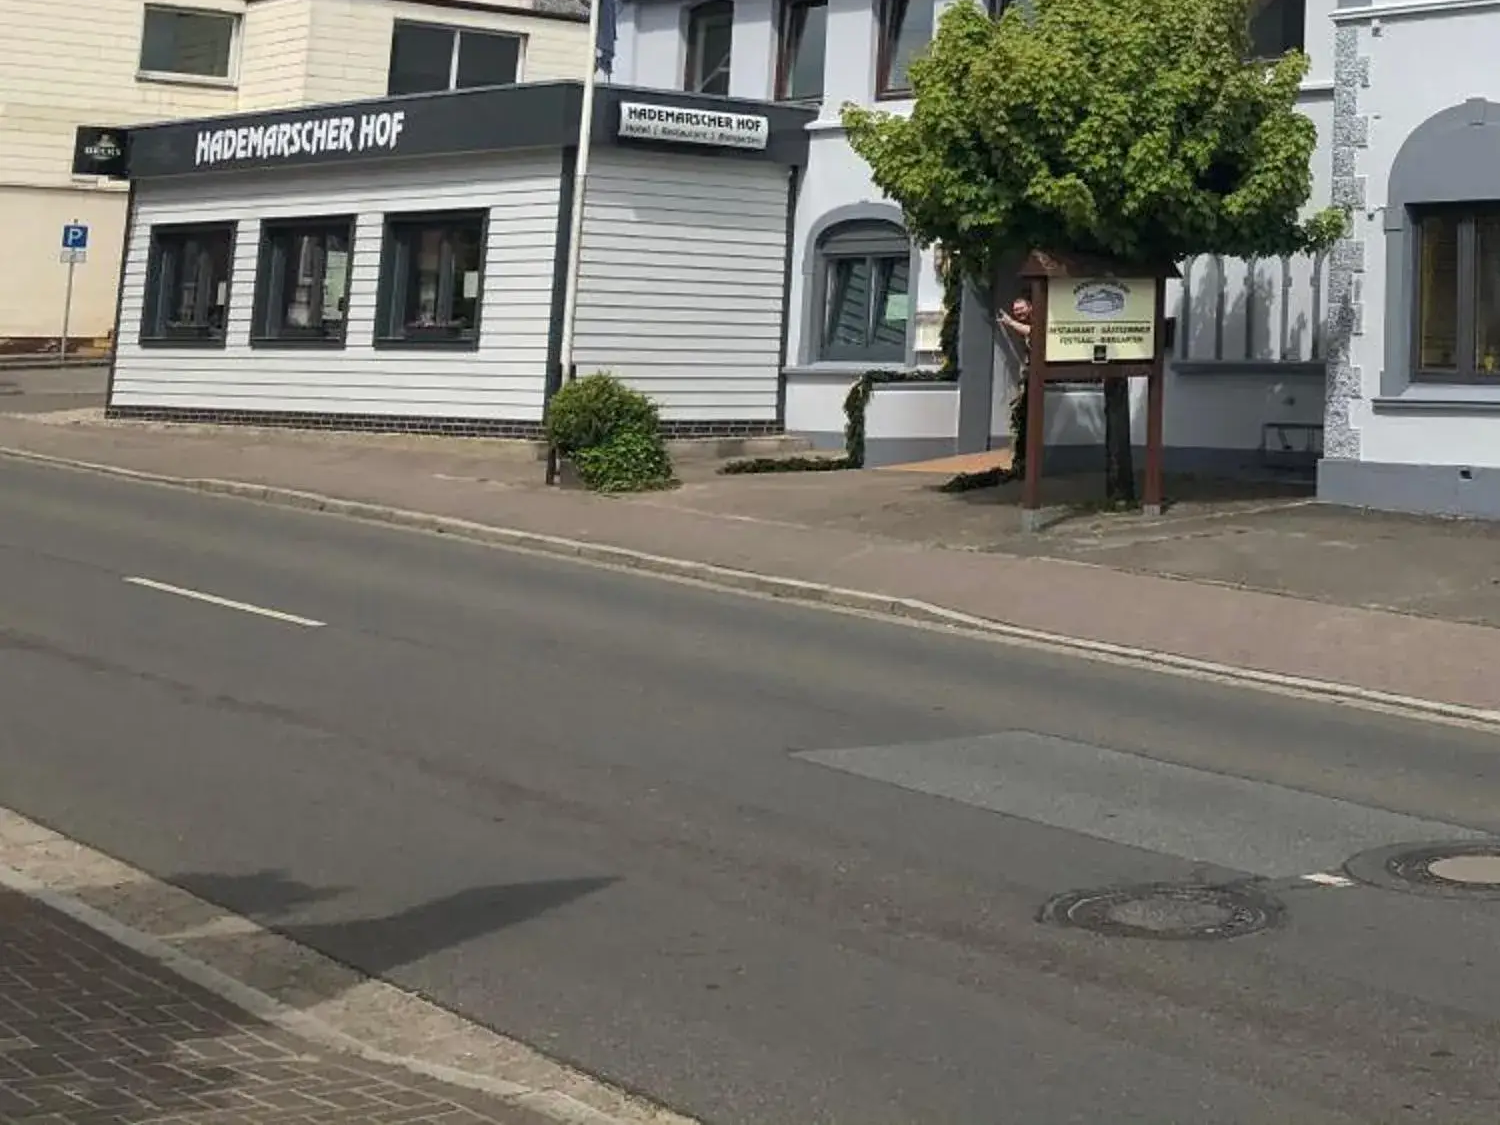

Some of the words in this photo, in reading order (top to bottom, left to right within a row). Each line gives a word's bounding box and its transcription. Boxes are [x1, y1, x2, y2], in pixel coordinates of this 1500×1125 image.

[627, 106, 733, 130] HADEMARSCHER
[737, 118, 761, 132] HOF
[195, 116, 353, 166] HADEMARSCHER
[358, 111, 405, 151] HOF
[68, 228, 83, 245] P
